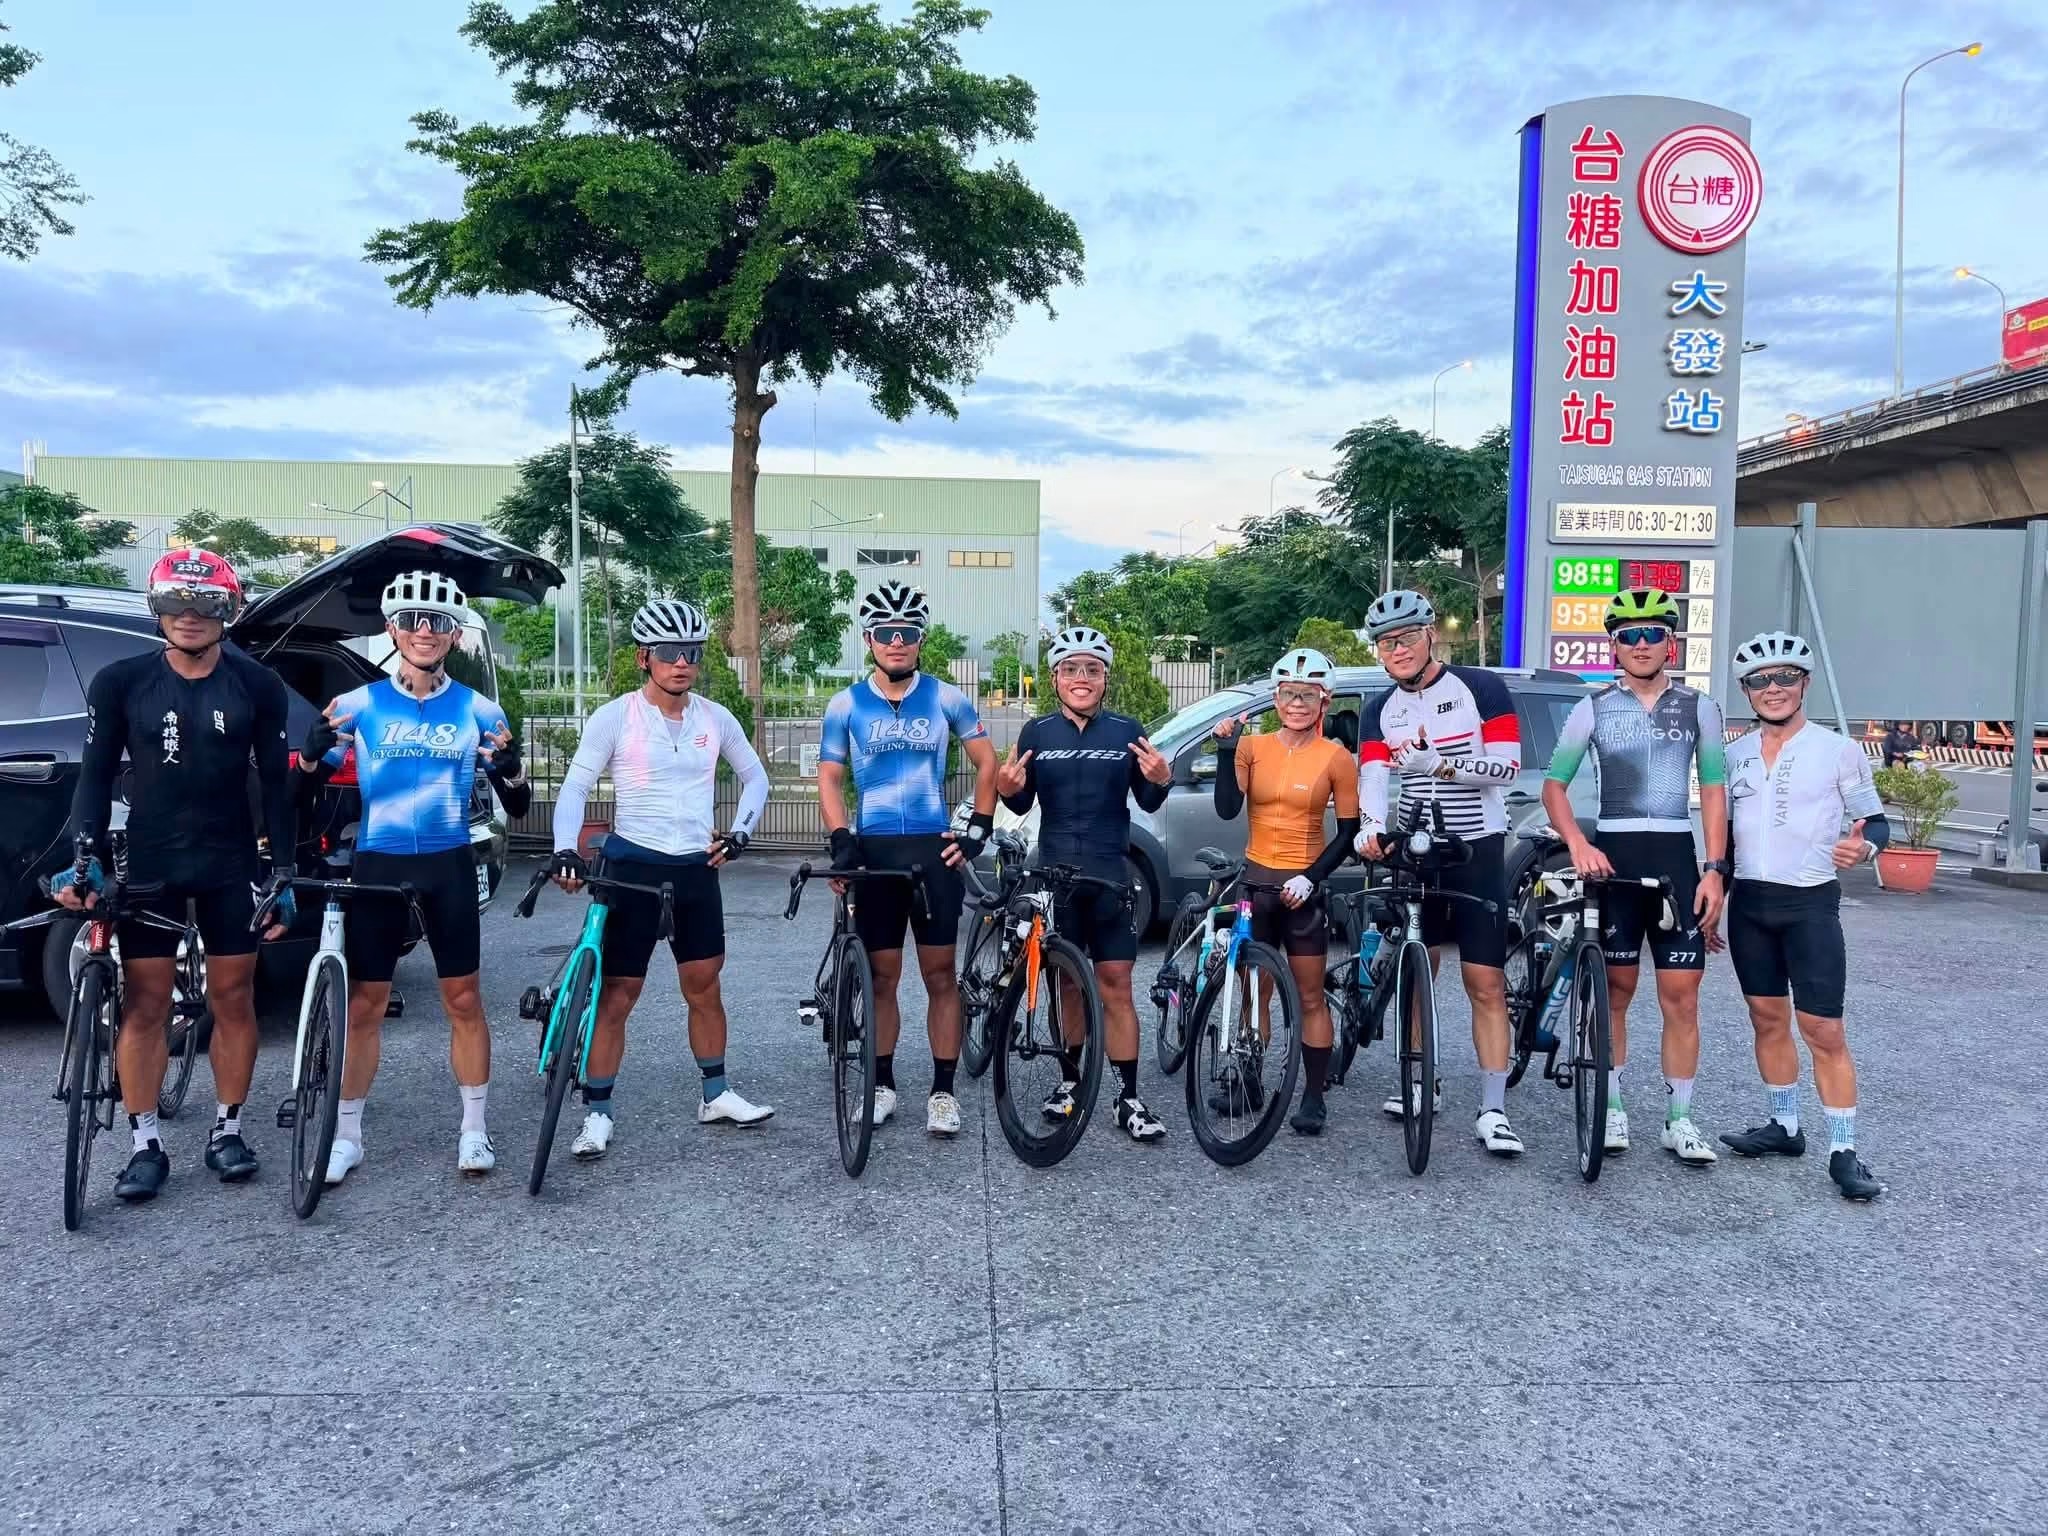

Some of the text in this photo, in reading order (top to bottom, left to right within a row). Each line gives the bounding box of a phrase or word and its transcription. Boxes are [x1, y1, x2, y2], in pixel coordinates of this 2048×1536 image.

[1667, 173, 1736, 207] 台糖
[1560, 125, 1625, 447] 台糖加油站
[1668, 269, 1728, 432] 大發站
[1559, 465, 1713, 487] TAISUGAR GAS STATION
[1559, 508, 1713, 533] 營業時間 06:30-21:30
[177, 563, 209, 574] 2357
[1558, 561, 1588, 586] 98
[1556, 602, 1587, 626] 95
[1554, 641, 1585, 665] 92
[378, 720, 458, 746] 148
[866, 717, 931, 743] 148
[372, 748, 464, 760] CYCLING TEAM
[864, 742, 938, 754] CYCLING TEAM
[1774, 755, 1796, 828] VAN RYSEL
[1669, 951, 1697, 963] 277
